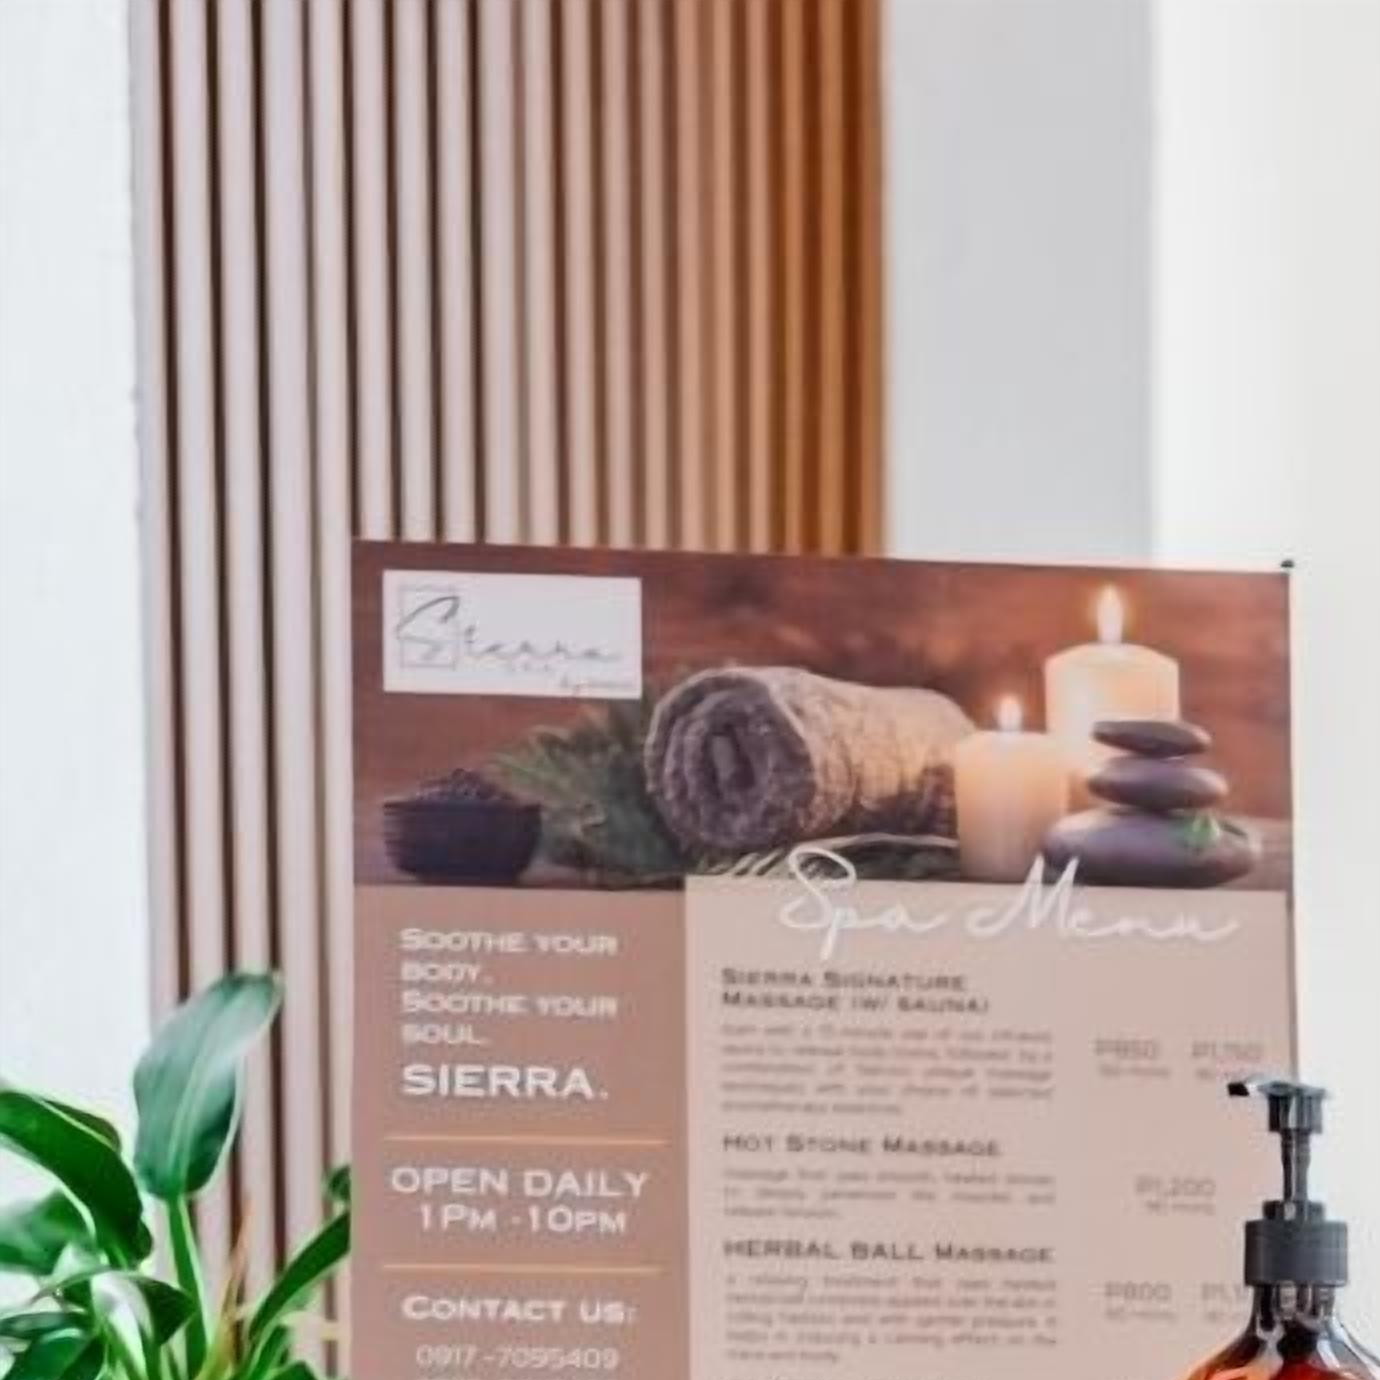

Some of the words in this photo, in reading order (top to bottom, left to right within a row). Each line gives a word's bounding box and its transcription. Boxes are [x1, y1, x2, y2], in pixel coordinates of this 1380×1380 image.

[779, 846, 948, 960] Spa
[965, 853, 1241, 943] Menu
[402, 1063, 609, 1101] SIERRA.
[390, 1166, 509, 1197] OPEN
[523, 1168, 649, 1199] DAILY
[852, 1242, 925, 1261] BALL
